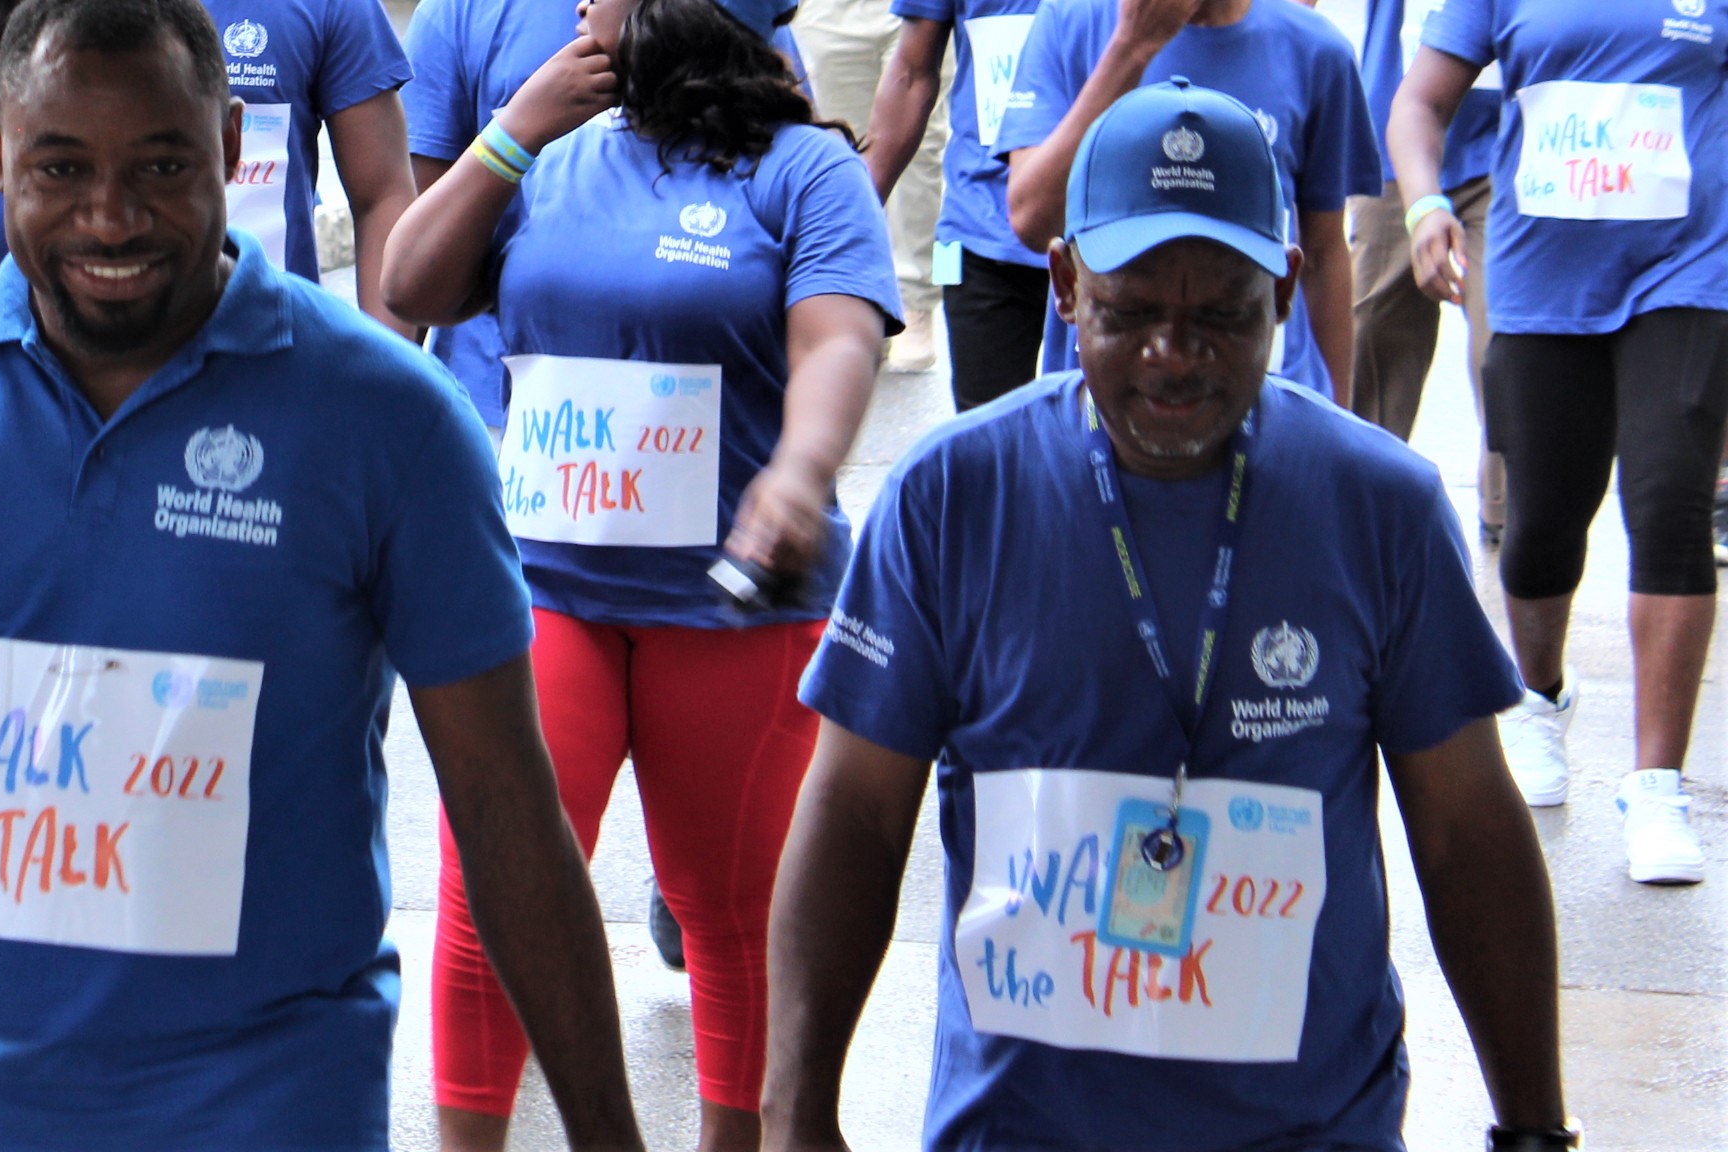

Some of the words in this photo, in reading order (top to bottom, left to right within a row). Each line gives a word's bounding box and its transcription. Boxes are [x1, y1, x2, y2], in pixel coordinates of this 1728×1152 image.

[225, 62, 241, 74] rld
[244, 63, 277, 76] Health
[228, 74, 275, 87] anization
[1537, 113, 1614, 156] WALK
[227, 160, 276, 185] 022
[1564, 157, 1636, 202] TALK
[655, 247, 729, 271] Organization
[659, 235, 692, 250] World
[694, 241, 731, 259] Health
[522, 398, 616, 460] WALK
[637, 425, 704, 455] 2022
[158, 484, 213, 514] World
[217, 491, 282, 525] Health
[505, 465, 546, 517] the
[556, 460, 645, 522] TALK
[155, 507, 278, 547] Organization
[1231, 696, 1281, 719] World
[1285, 695, 1329, 718] Health
[123, 753, 224, 800] 2022
[1206, 872, 1303, 919] 2022
[976, 937, 1054, 1009] the
[1071, 931, 1213, 1019] TALK
